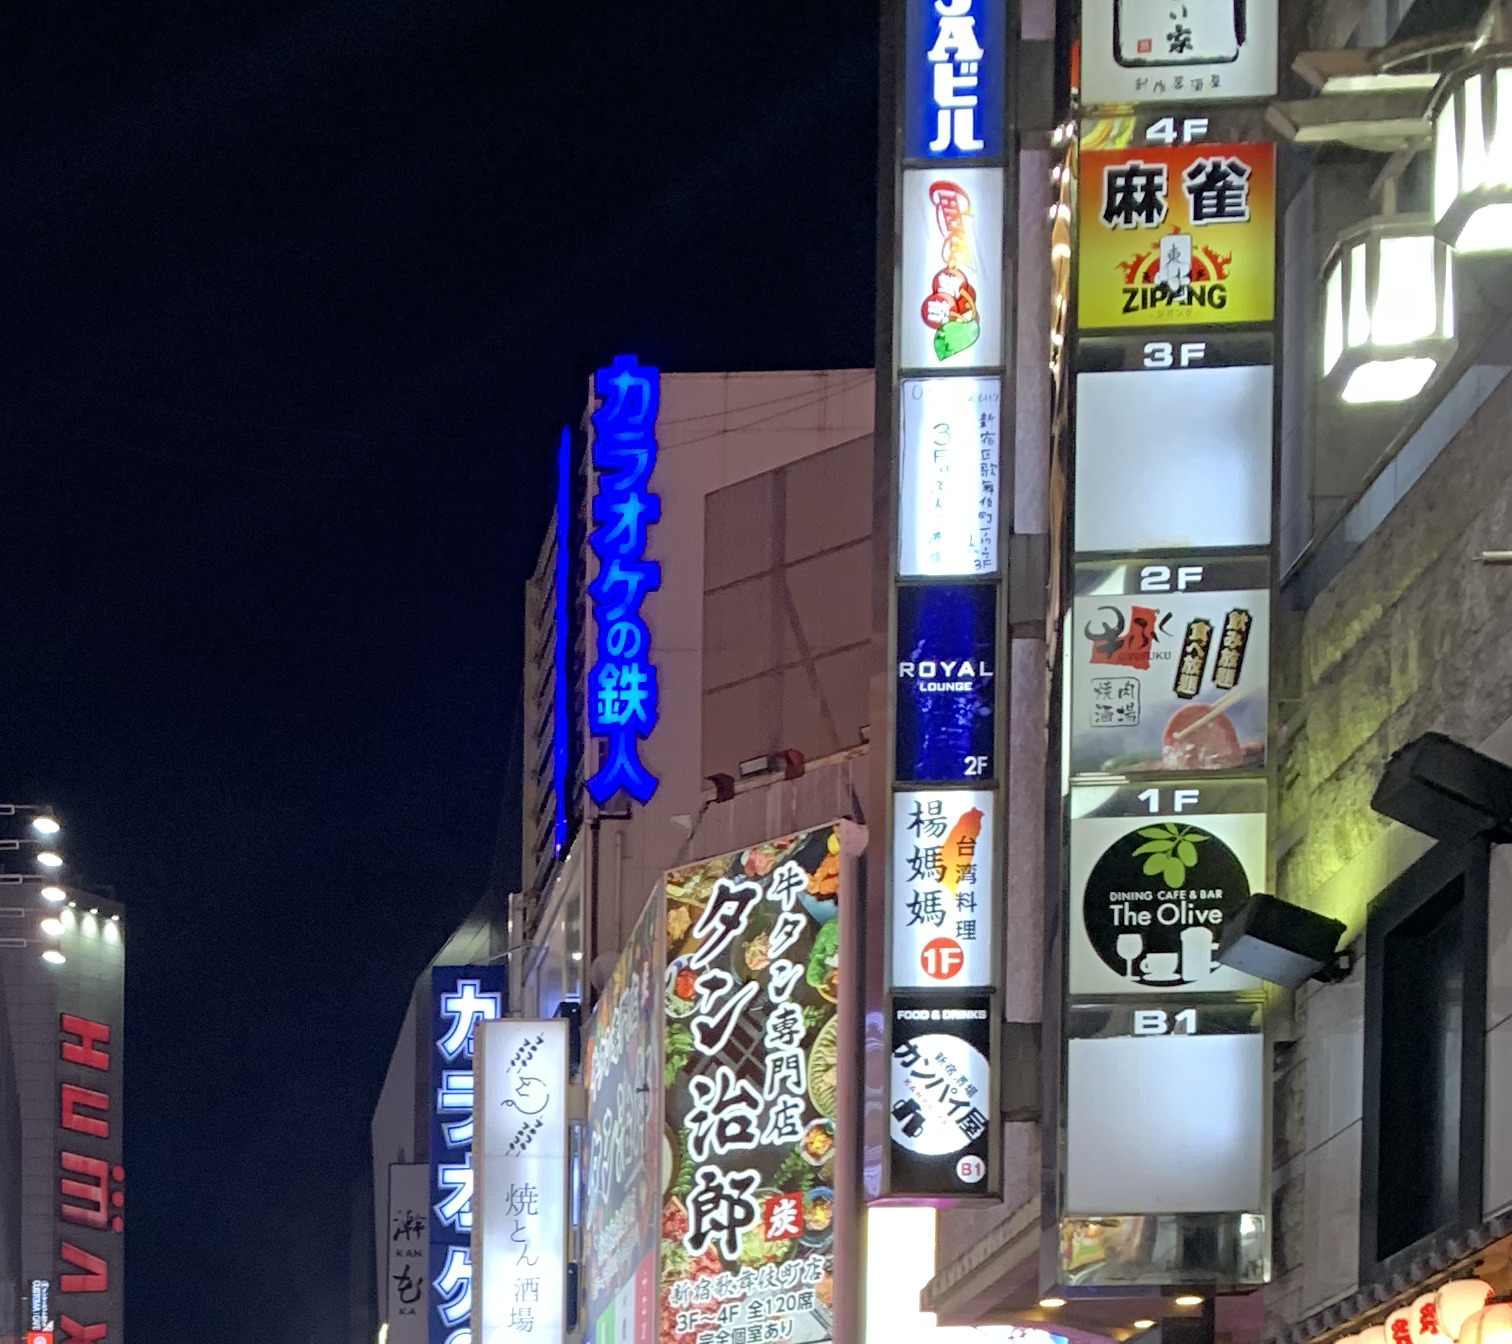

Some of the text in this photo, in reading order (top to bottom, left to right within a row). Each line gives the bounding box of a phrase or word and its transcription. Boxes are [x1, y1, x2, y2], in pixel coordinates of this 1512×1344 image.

[1146, 117, 1208, 143] 4F
[1099, 156, 1252, 228] 麻雀
[1122, 283, 1228, 315] ZIPANG
[1143, 342, 1206, 367] 3F
[592, 355, 660, 804] カラオケの鉄人
[1140, 566, 1203, 590] 2F
[899, 662, 994, 679] ROYAL
[919, 680, 973, 692] LOUNGE
[964, 755, 989, 776] 2F
[1137, 787, 1200, 813] 1F
[906, 799, 948, 929] 楊媽媽
[955, 834, 978, 941] 台湾料理
[1109, 890, 1223, 901] DINING CAFE & BAR
[1109, 902, 1223, 928] The Olive
[924, 947, 963, 974] 1F
[765, 860, 806, 1147] 牛タン専門店
[897, 1009, 929, 1021] FOOD
[943, 1009, 987, 1021] DRINKS
[1134, 1010, 1199, 1035] B1
[935, 1052, 979, 1098] 新宿酒場
[894, 1041, 986, 1143] カンパイ屋
[961, 1163, 983, 1179] B1
[766, 1196, 803, 1241] 炭
[505, 1182, 540, 1334] 焼とん酒場
[671, 1268, 825, 1305] 新宿歌舞伎町店
[748, 1294, 814, 1321] 全120席
